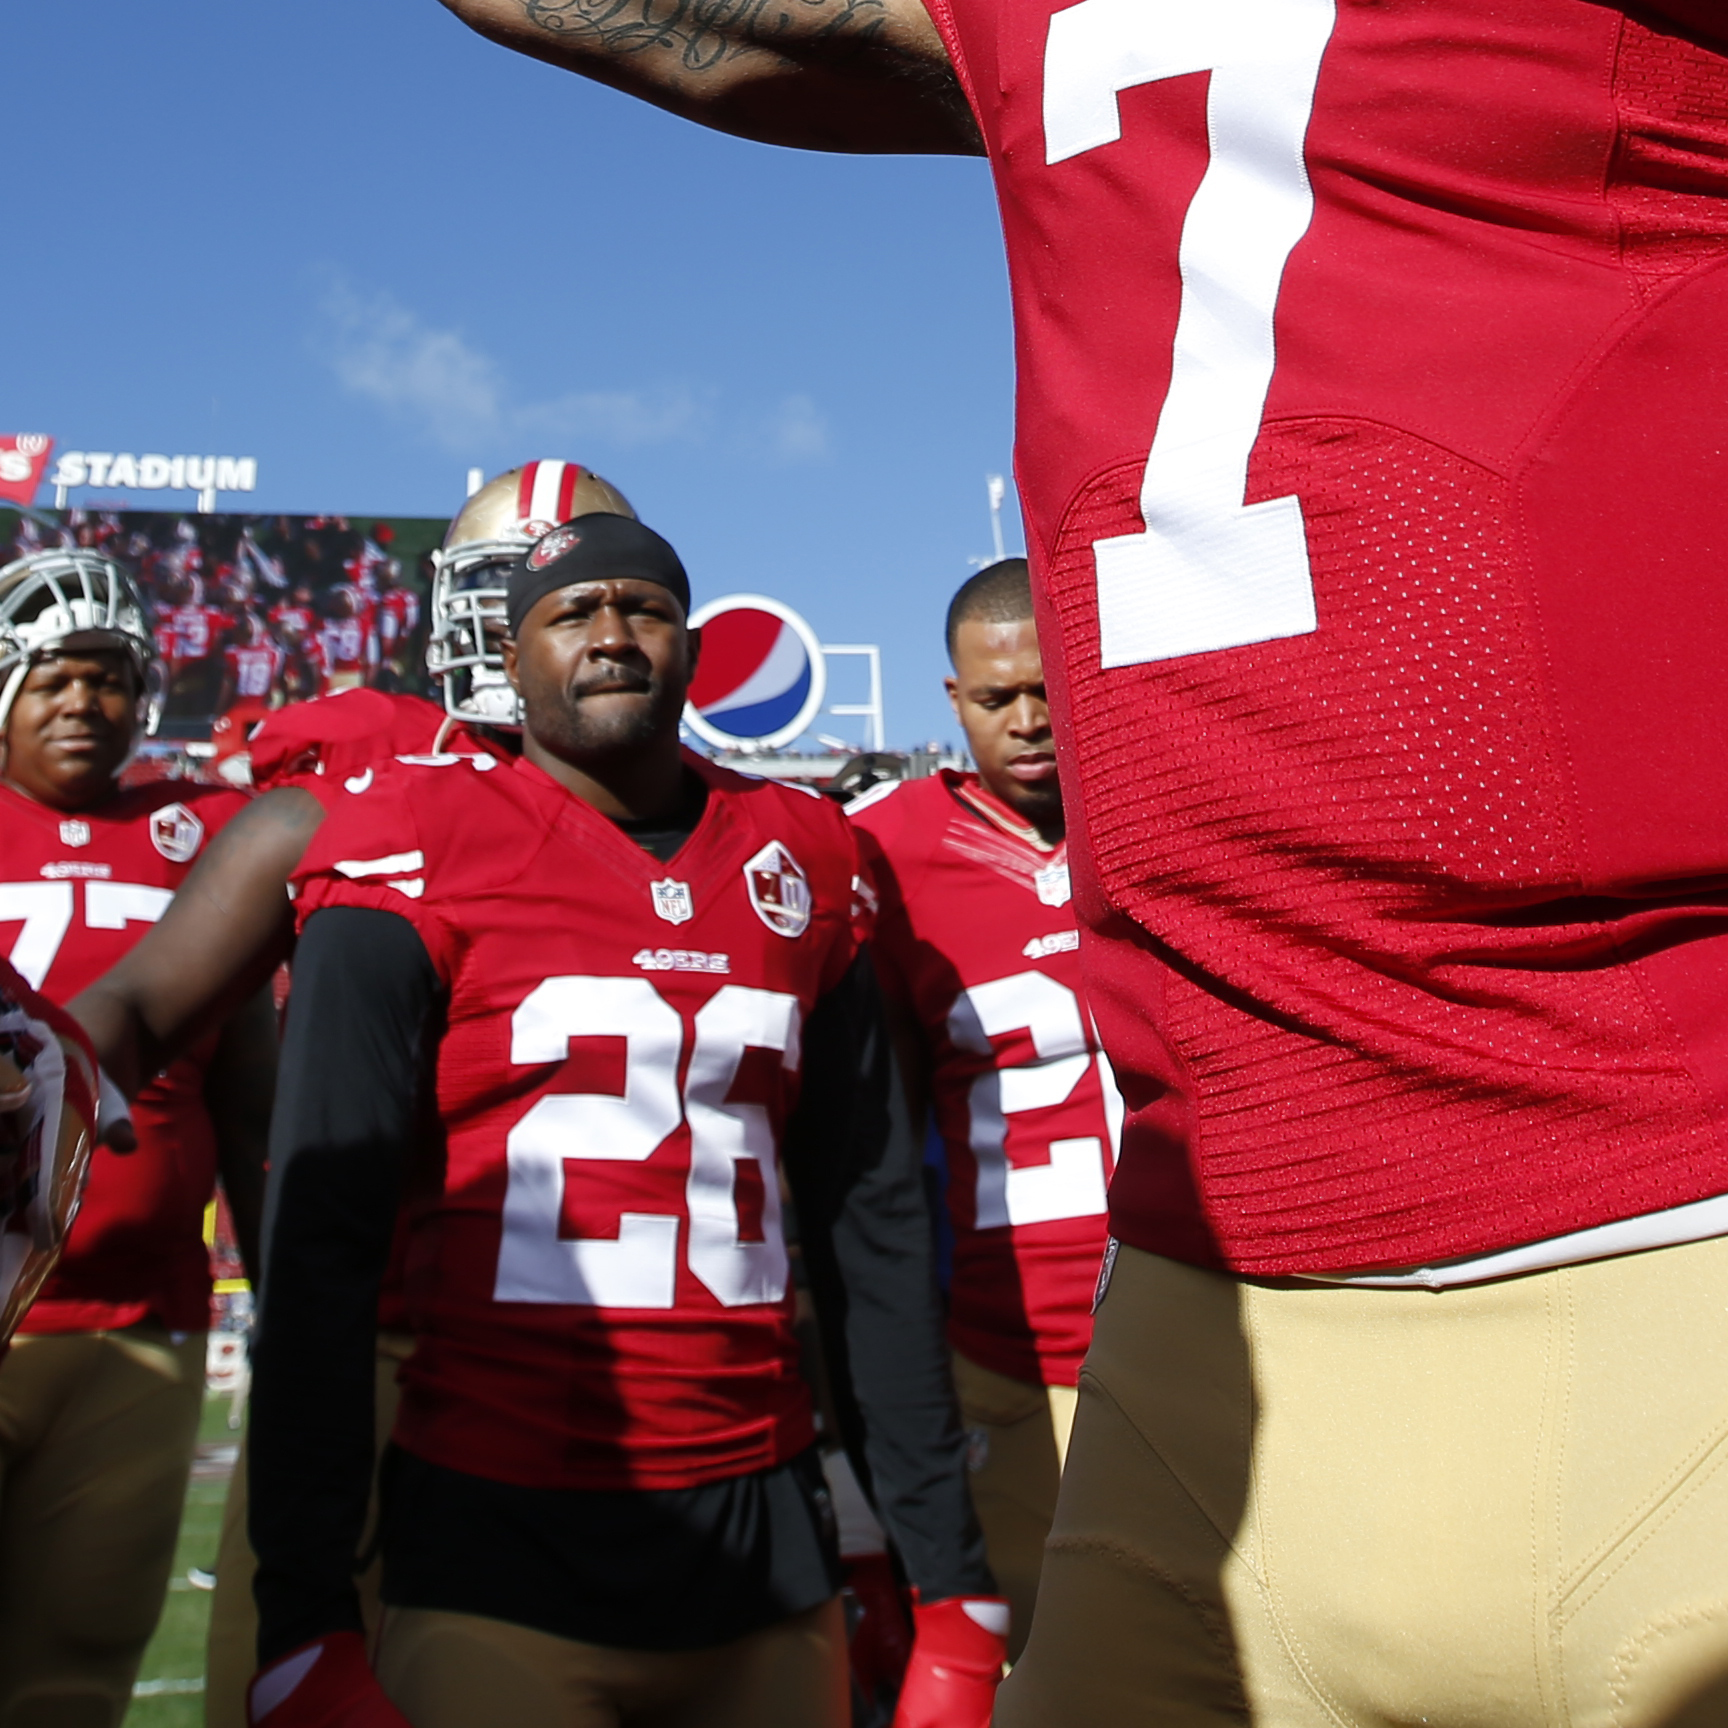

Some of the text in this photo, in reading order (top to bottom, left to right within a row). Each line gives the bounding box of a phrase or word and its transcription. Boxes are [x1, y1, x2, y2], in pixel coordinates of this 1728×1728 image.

[56, 451, 257, 492] STADIUM
[660, 897, 688, 916] NFL
[631, 947, 732, 974] 49ERS
[948, 968, 1126, 1232] 2
[494, 974, 802, 1310] 26
